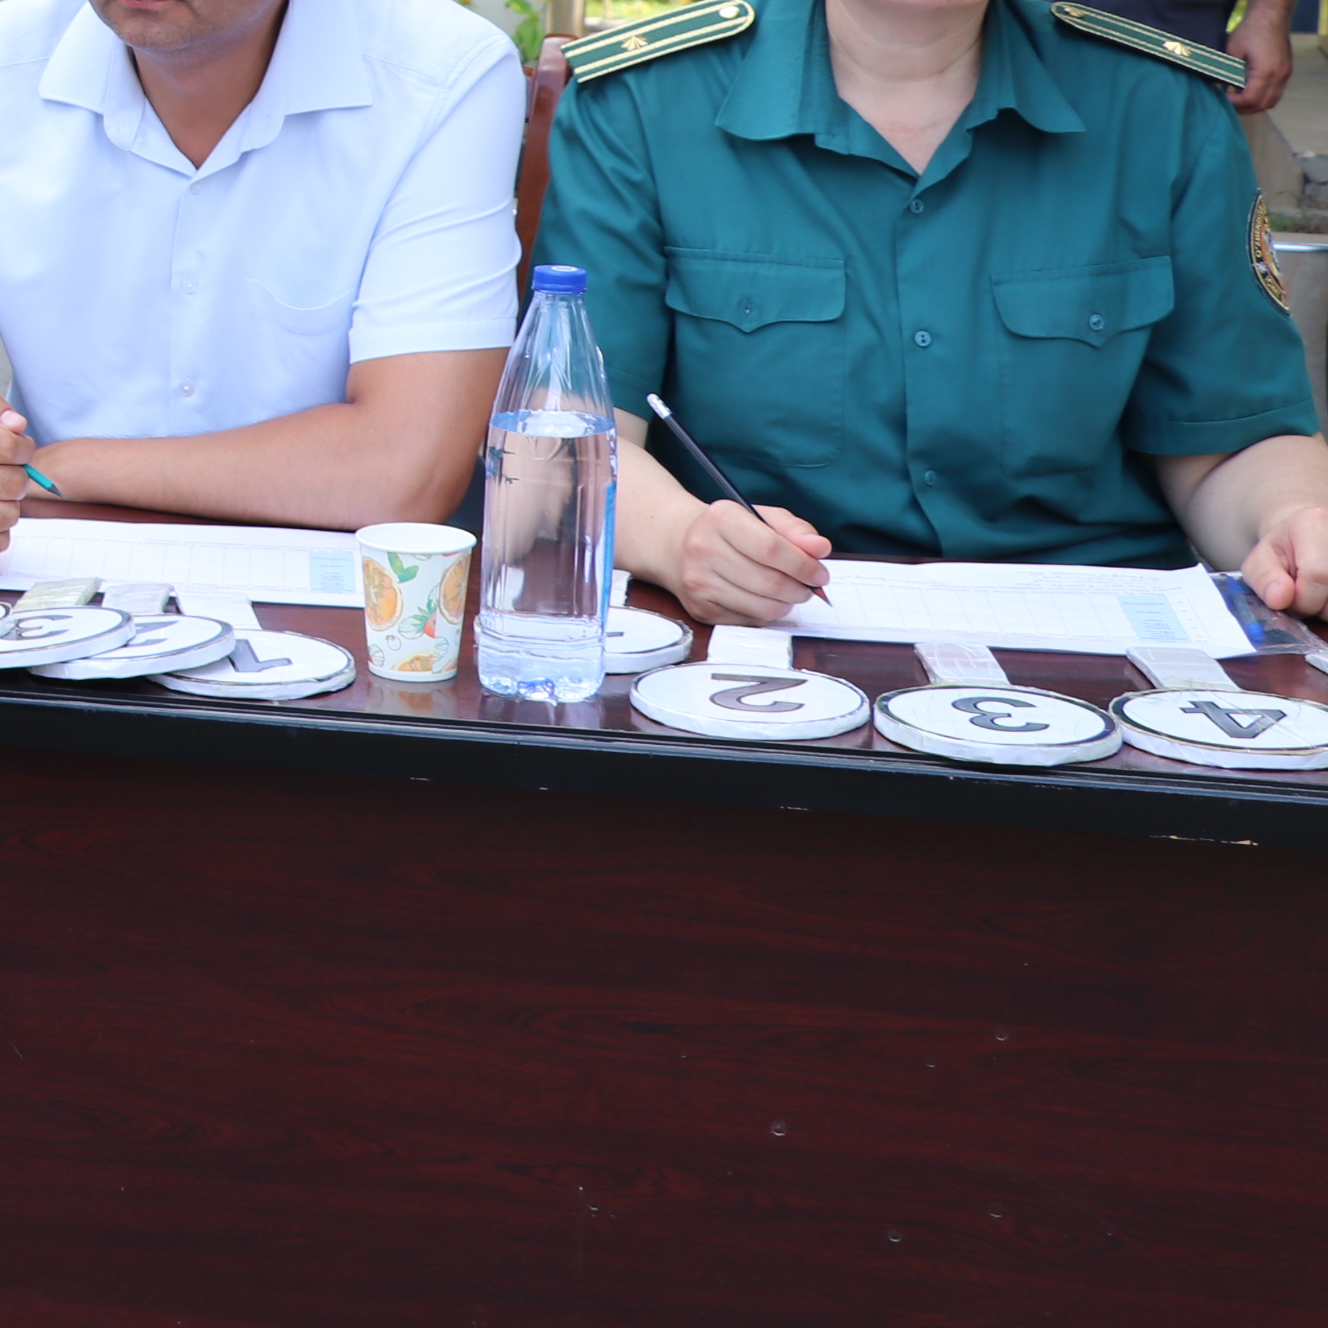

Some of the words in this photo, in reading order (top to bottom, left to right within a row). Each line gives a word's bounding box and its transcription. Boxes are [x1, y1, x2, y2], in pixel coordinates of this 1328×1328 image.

[0, 615, 73, 641] 3
[229, 638, 293, 673] 1
[709, 672, 809, 713] 2
[951, 696, 1050, 732] 3
[1179, 700, 1288, 739] 4
